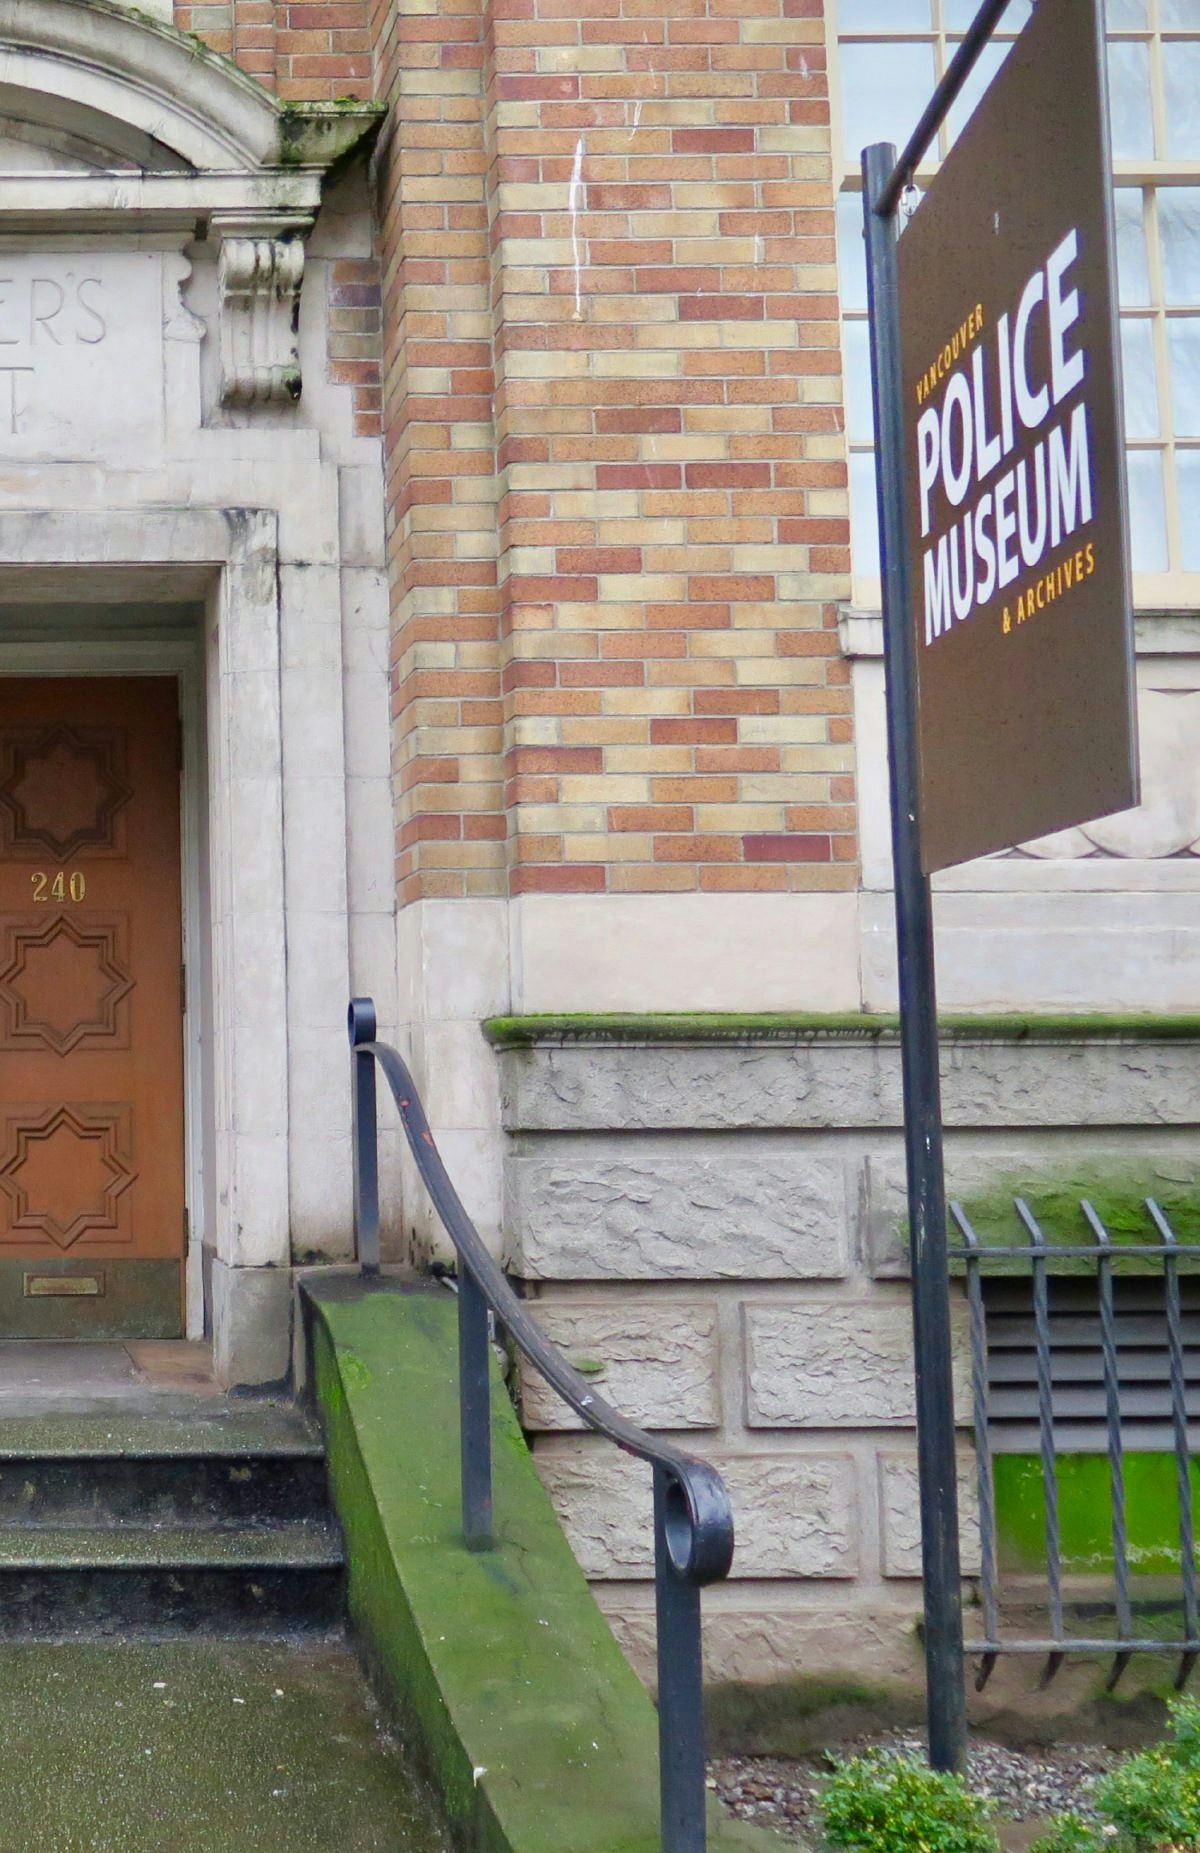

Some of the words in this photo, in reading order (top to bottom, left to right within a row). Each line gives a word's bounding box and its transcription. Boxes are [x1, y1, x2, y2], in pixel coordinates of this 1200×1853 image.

[916, 303, 984, 405] VANCOUVER
[917, 228, 1085, 538] POLICE
[922, 402, 1093, 647] MUSEUM
[1002, 606, 1011, 634] &
[1017, 542, 1096, 625] ARCHIVES
[31, 871, 86, 902] 240
